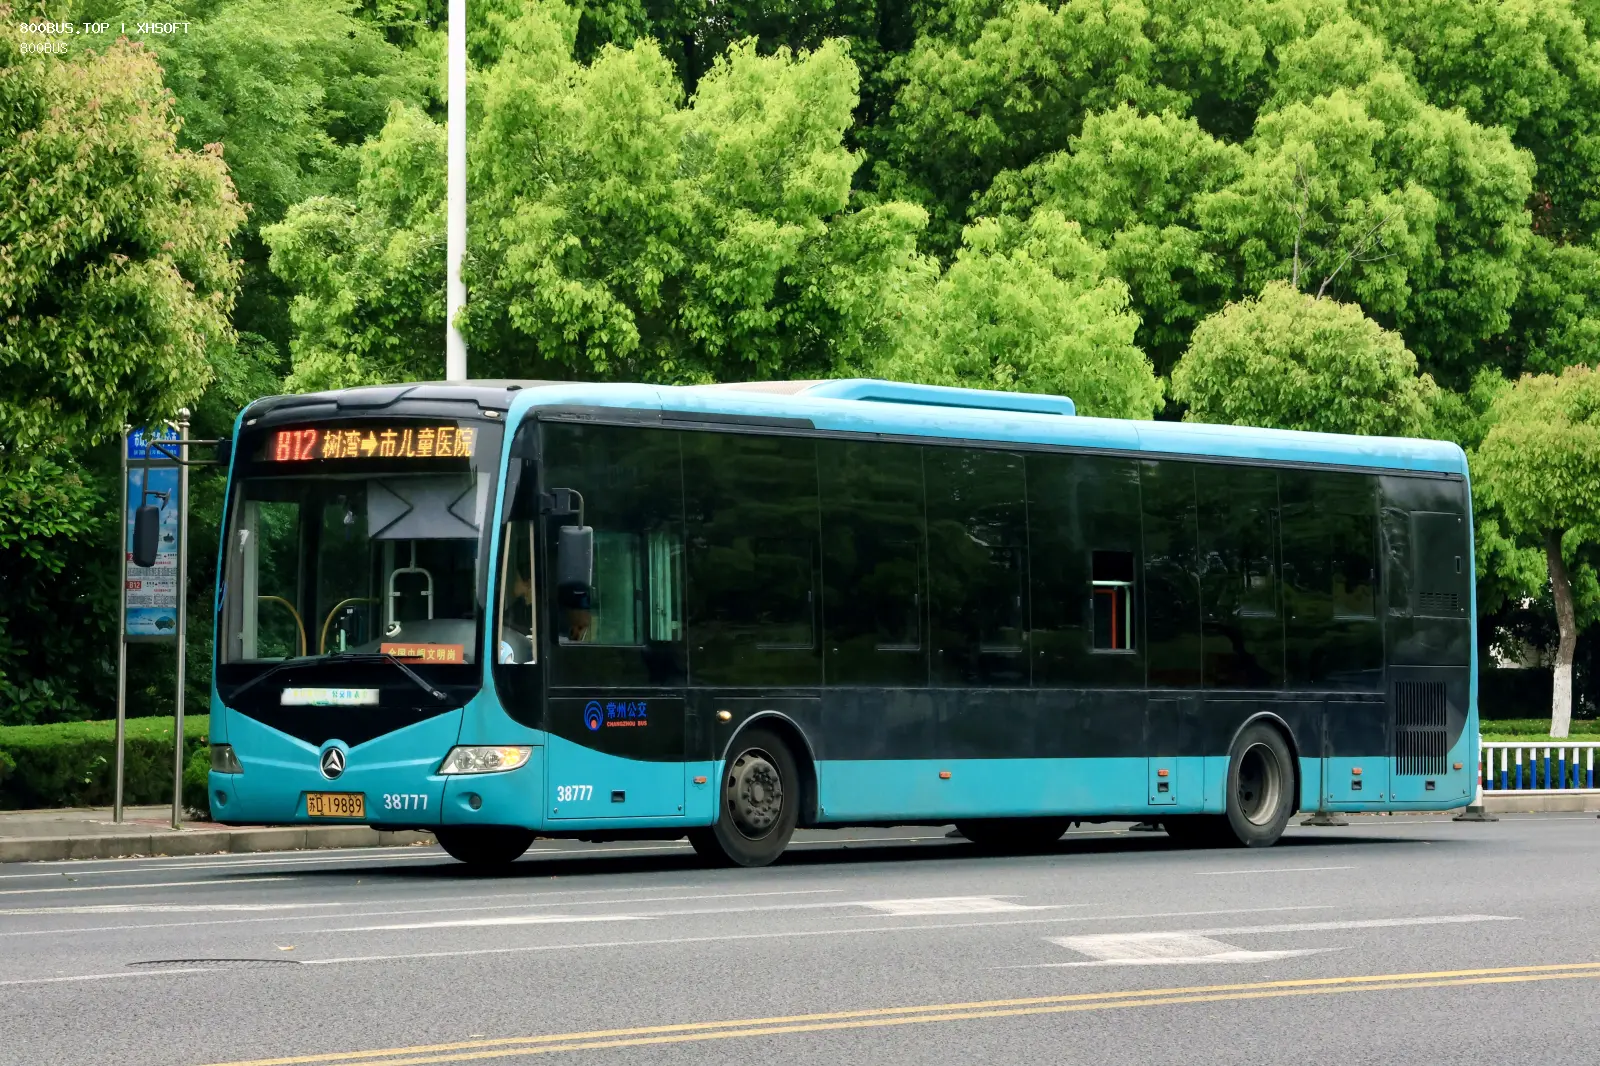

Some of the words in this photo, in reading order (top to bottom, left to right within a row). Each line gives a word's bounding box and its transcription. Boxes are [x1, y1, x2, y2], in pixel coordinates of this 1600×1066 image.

[275, 429, 316, 461] B12
[322, 430, 361, 458] 树湾
[380, 427, 473, 458] 市儿童医院
[606, 701, 647, 718] 常州公交
[382, 793, 428, 810] 38777
[556, 785, 593, 802] 38777
